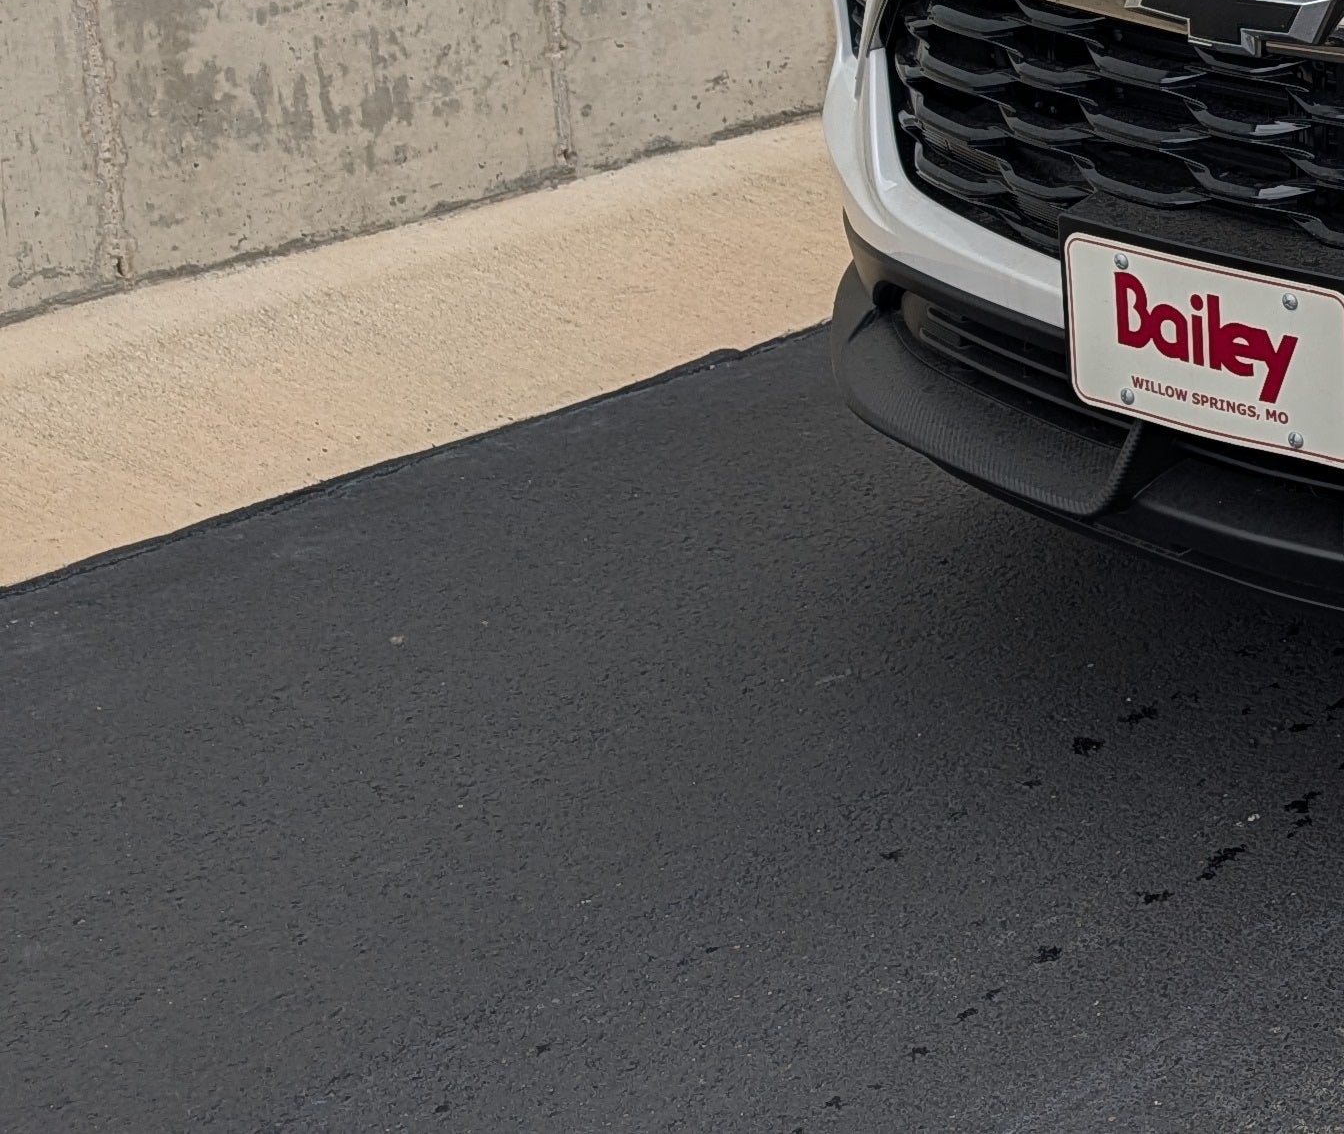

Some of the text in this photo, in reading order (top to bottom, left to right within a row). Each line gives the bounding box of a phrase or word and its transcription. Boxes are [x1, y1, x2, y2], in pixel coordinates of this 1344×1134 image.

[1113, 271, 1299, 404] Bailey
[1130, 374, 1290, 425] WILLOW SPRINGS, MO
